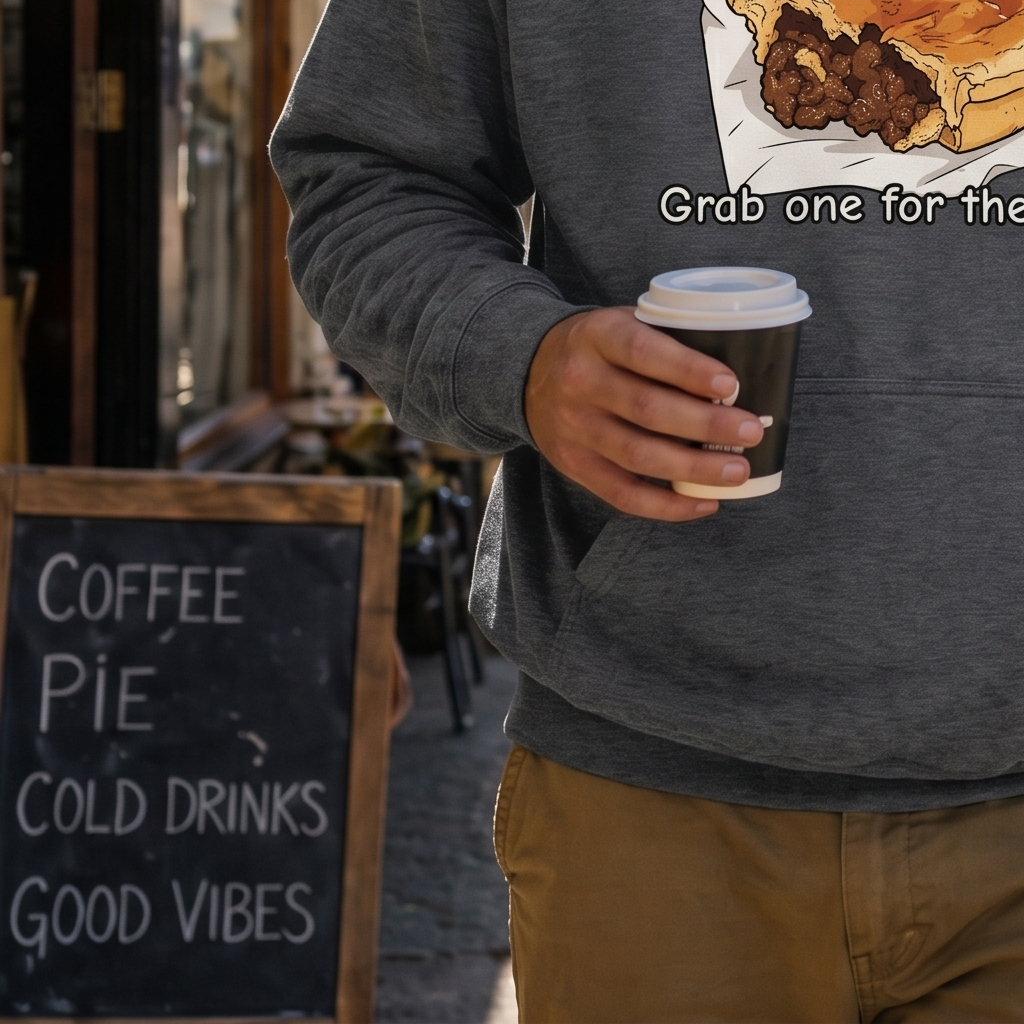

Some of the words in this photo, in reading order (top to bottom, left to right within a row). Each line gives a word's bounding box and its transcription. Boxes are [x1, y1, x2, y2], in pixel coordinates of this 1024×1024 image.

[660, 185, 765, 224] Grab
[784, 196, 864, 223] one
[881, 185, 946, 224] for
[37, 551, 246, 625] COFFEE
[15, 770, 148, 837] COLD
[164, 775, 330, 838] DRINKS
[9, 875, 152, 960] GOOD
[171, 878, 316, 945] VIBES
